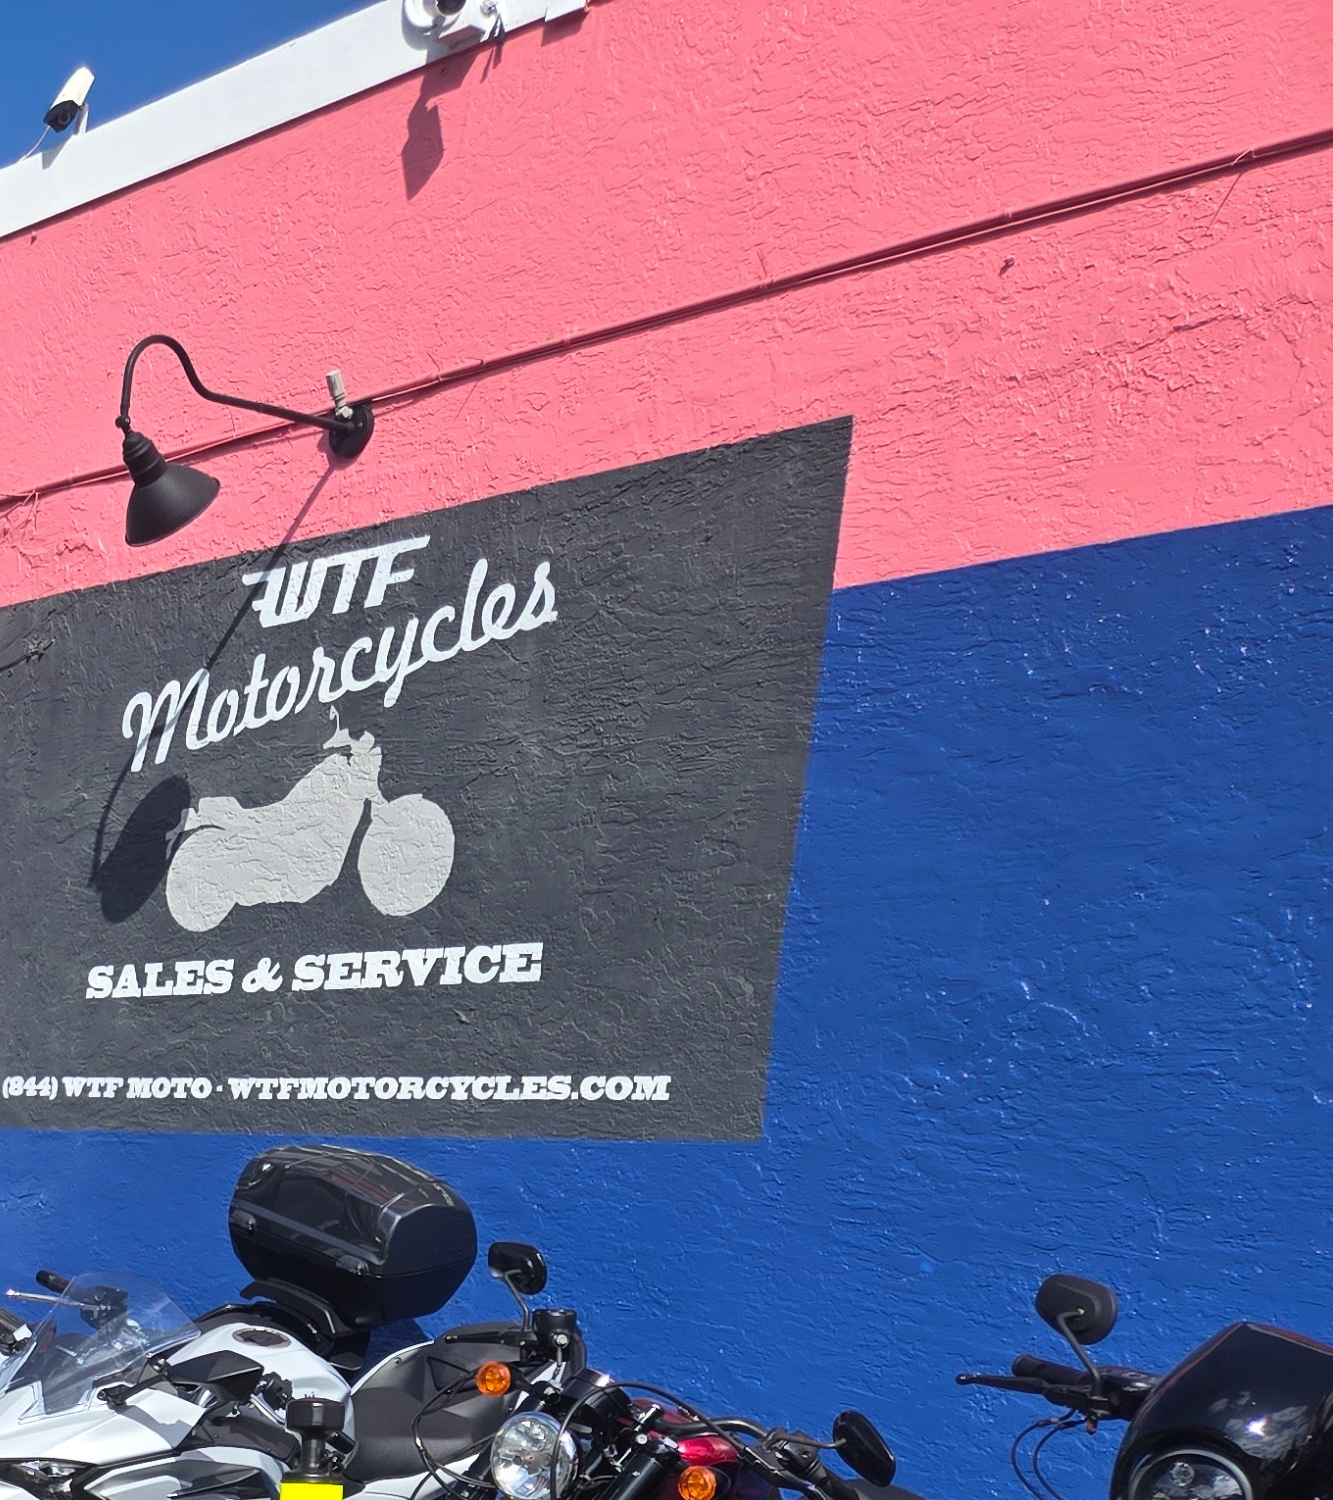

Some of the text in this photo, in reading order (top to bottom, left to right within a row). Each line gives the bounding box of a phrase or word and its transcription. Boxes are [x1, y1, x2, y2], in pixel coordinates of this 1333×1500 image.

[242, 535, 430, 627] WTF
[123, 557, 558, 773] Motorcycles
[85, 942, 544, 999] SALES & SERVICE
[2, 1075, 59, 1100] (844)
[62, 1076, 124, 1099] WTF
[126, 1076, 213, 1099] MOTO
[228, 1075, 673, 1101] WTFMOTORCYCLES.COM
